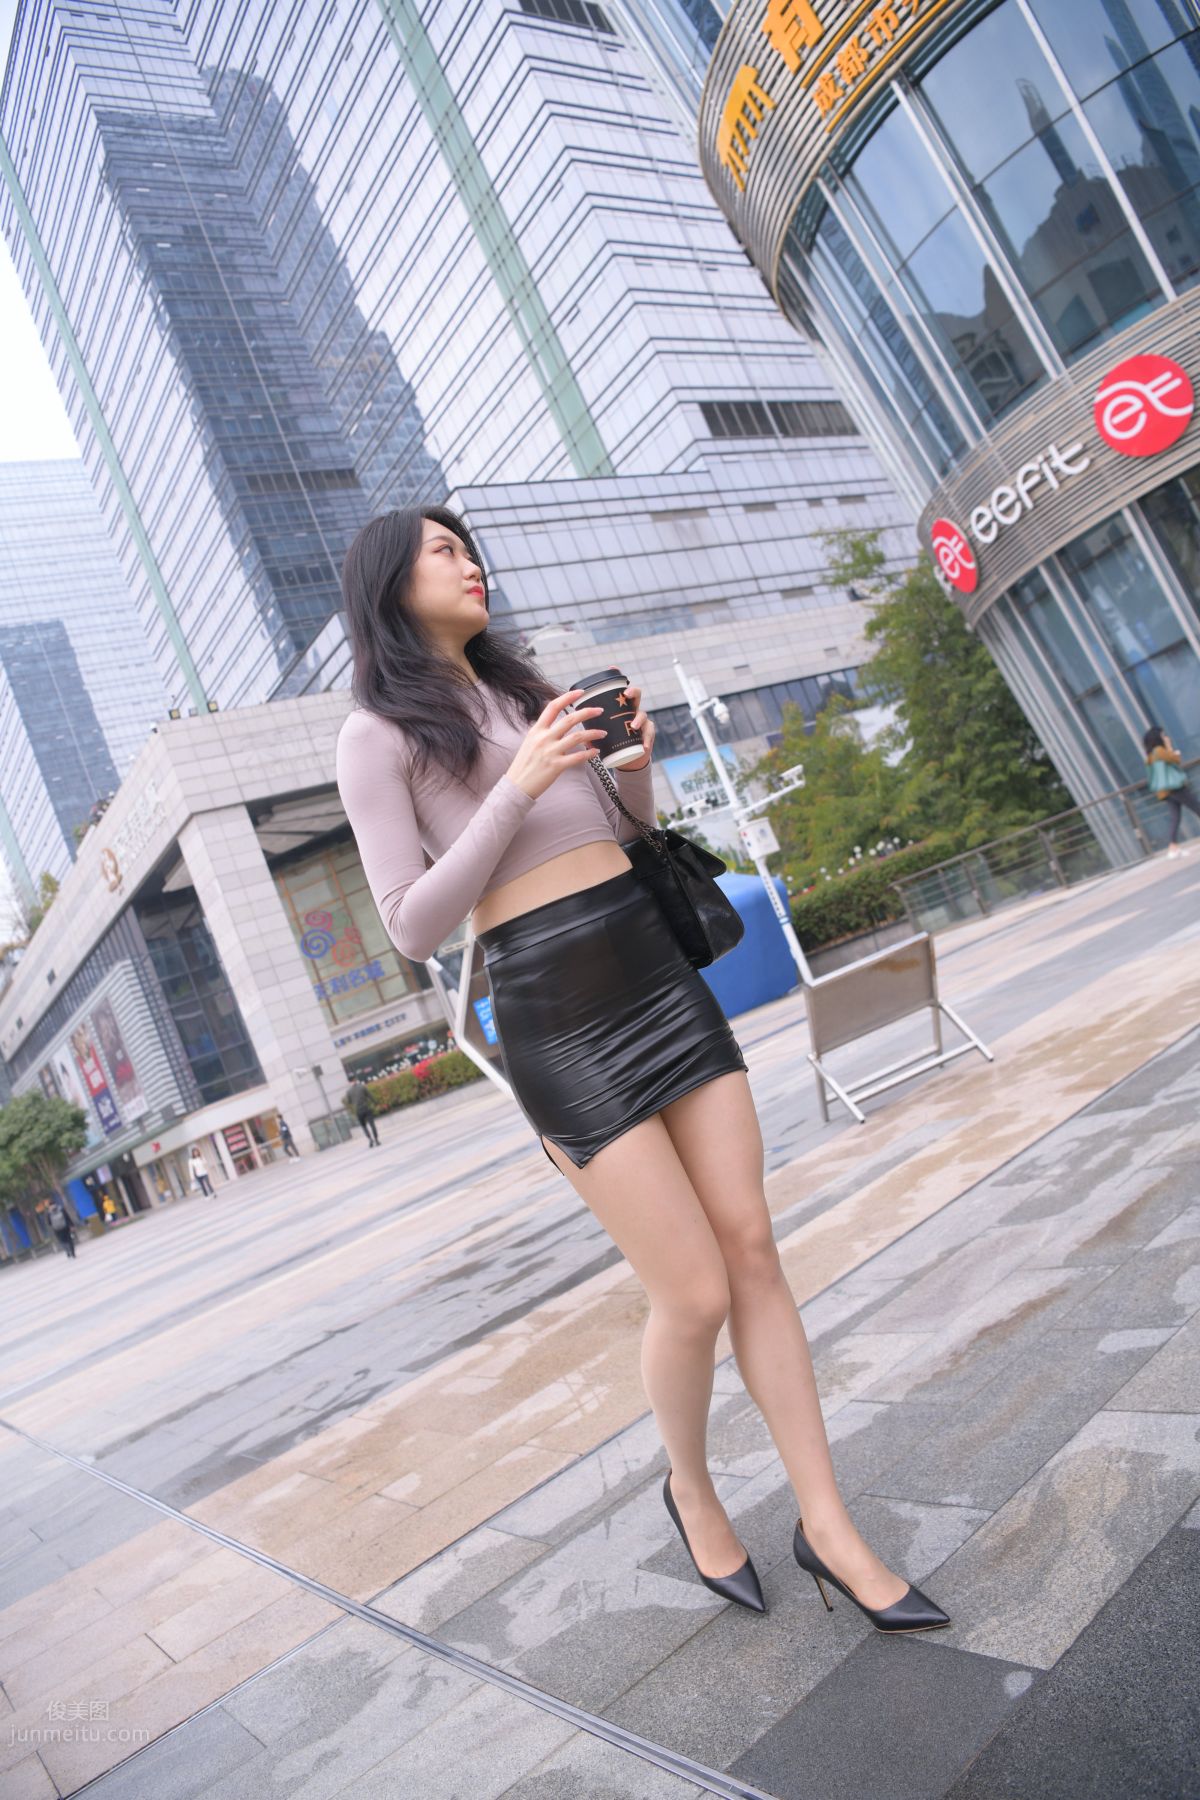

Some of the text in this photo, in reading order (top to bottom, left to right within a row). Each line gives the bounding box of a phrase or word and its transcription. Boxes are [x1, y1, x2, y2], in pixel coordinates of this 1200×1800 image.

[811, 0, 919, 121] 成都市
[970, 443, 1091, 545] eefit
